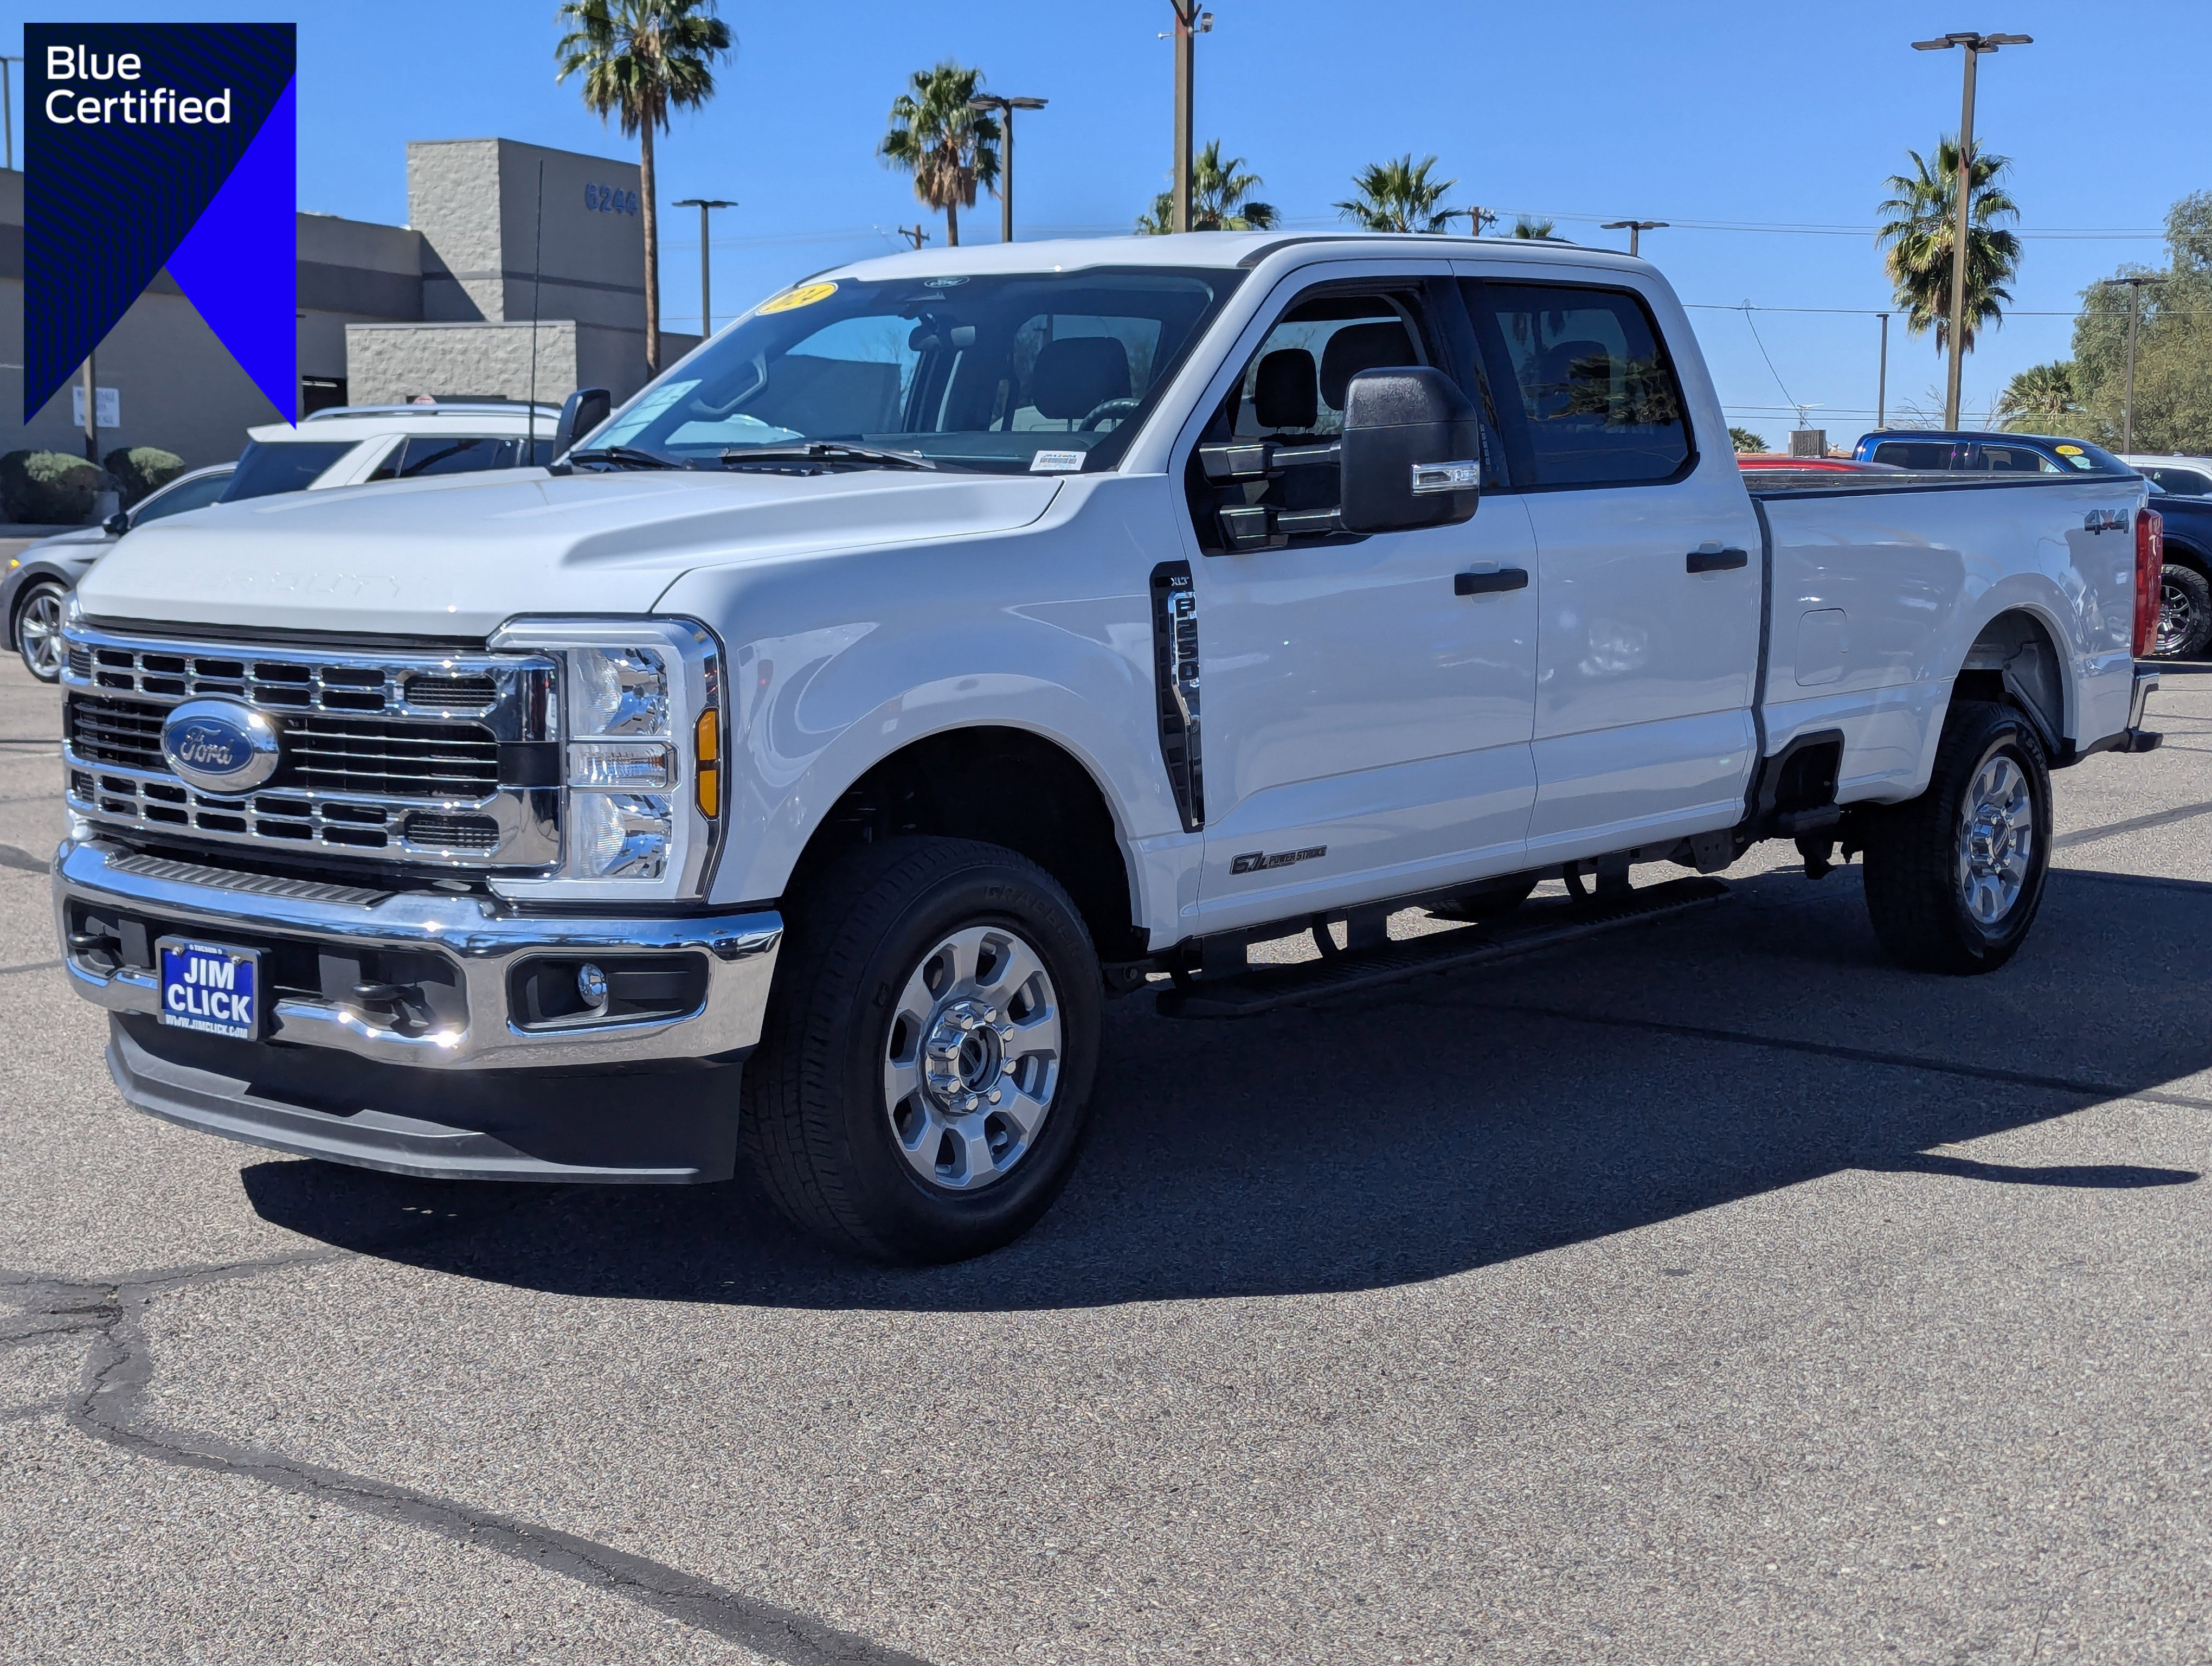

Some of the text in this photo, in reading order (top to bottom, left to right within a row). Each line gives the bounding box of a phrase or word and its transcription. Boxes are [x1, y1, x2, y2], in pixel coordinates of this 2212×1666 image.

[585, 184, 638, 216] 6244
[1171, 576, 1189, 586] XLT
[180, 725, 233, 765] Ford
[184, 957, 234, 990] JIM
[168, 984, 252, 1023] CLICK
